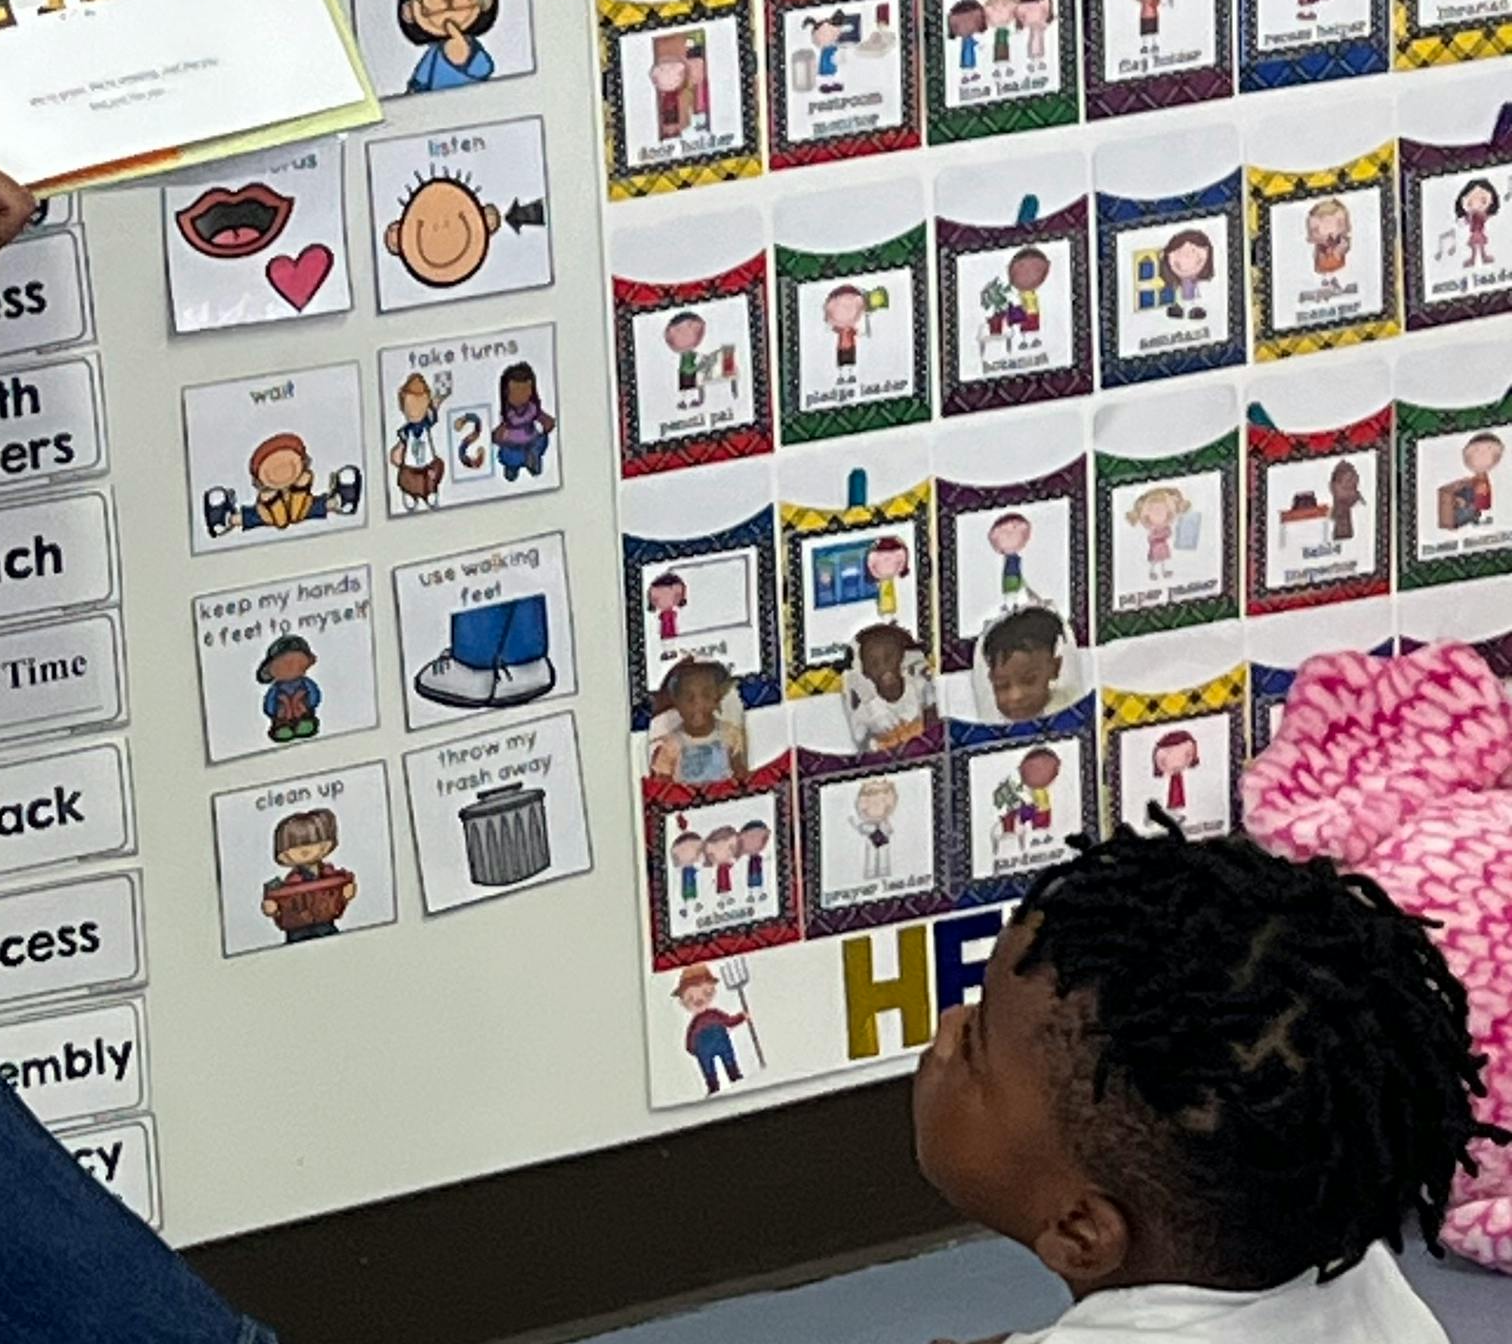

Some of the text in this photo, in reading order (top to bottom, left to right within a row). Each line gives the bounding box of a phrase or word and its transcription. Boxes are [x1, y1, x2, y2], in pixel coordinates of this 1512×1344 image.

[427, 136, 486, 157] listen
[408, 337, 518, 369] take turns
[249, 380, 295, 404] wait
[418, 547, 540, 588] use walking
[199, 575, 361, 621] keep my hands
[460, 582, 502, 606] feet
[219, 620, 262, 644] feet
[269, 618, 289, 635] to
[297, 601, 371, 633] myself
[2, 654, 87, 691] Time
[438, 731, 537, 769] throw my
[436, 755, 552, 796] trash away
[255, 779, 345, 812] clean up
